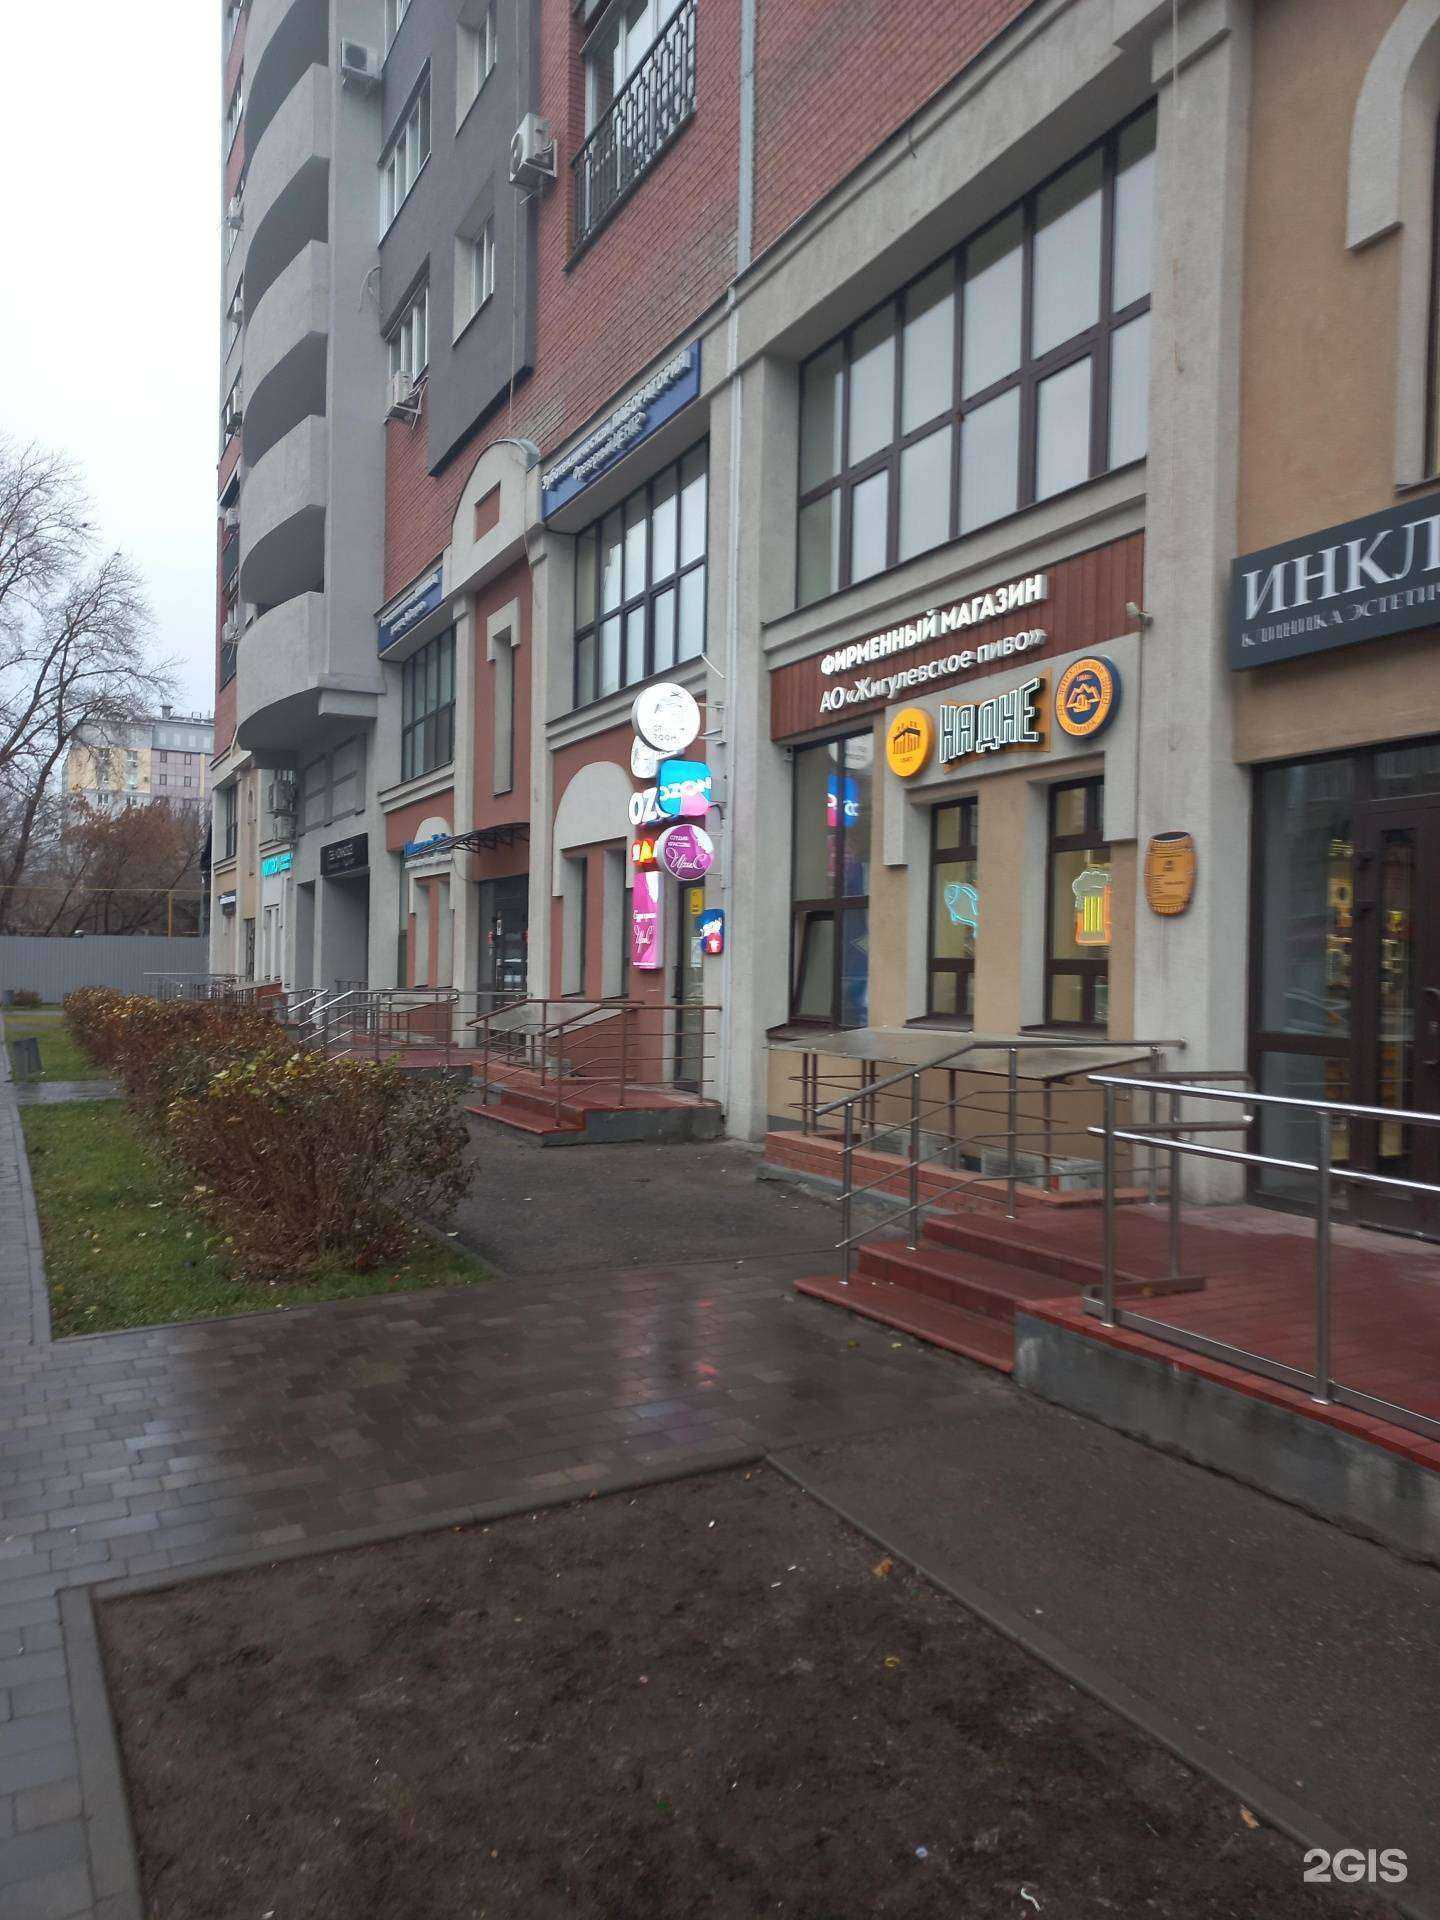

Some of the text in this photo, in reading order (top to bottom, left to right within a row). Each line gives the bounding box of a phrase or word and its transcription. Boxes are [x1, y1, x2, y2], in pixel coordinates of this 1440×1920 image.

[819, 686, 845, 713] АО
[977, 629, 1048, 664] пиво»
[820, 574, 1047, 677] ФИРМЕННЫЙ МАГАЗИН
